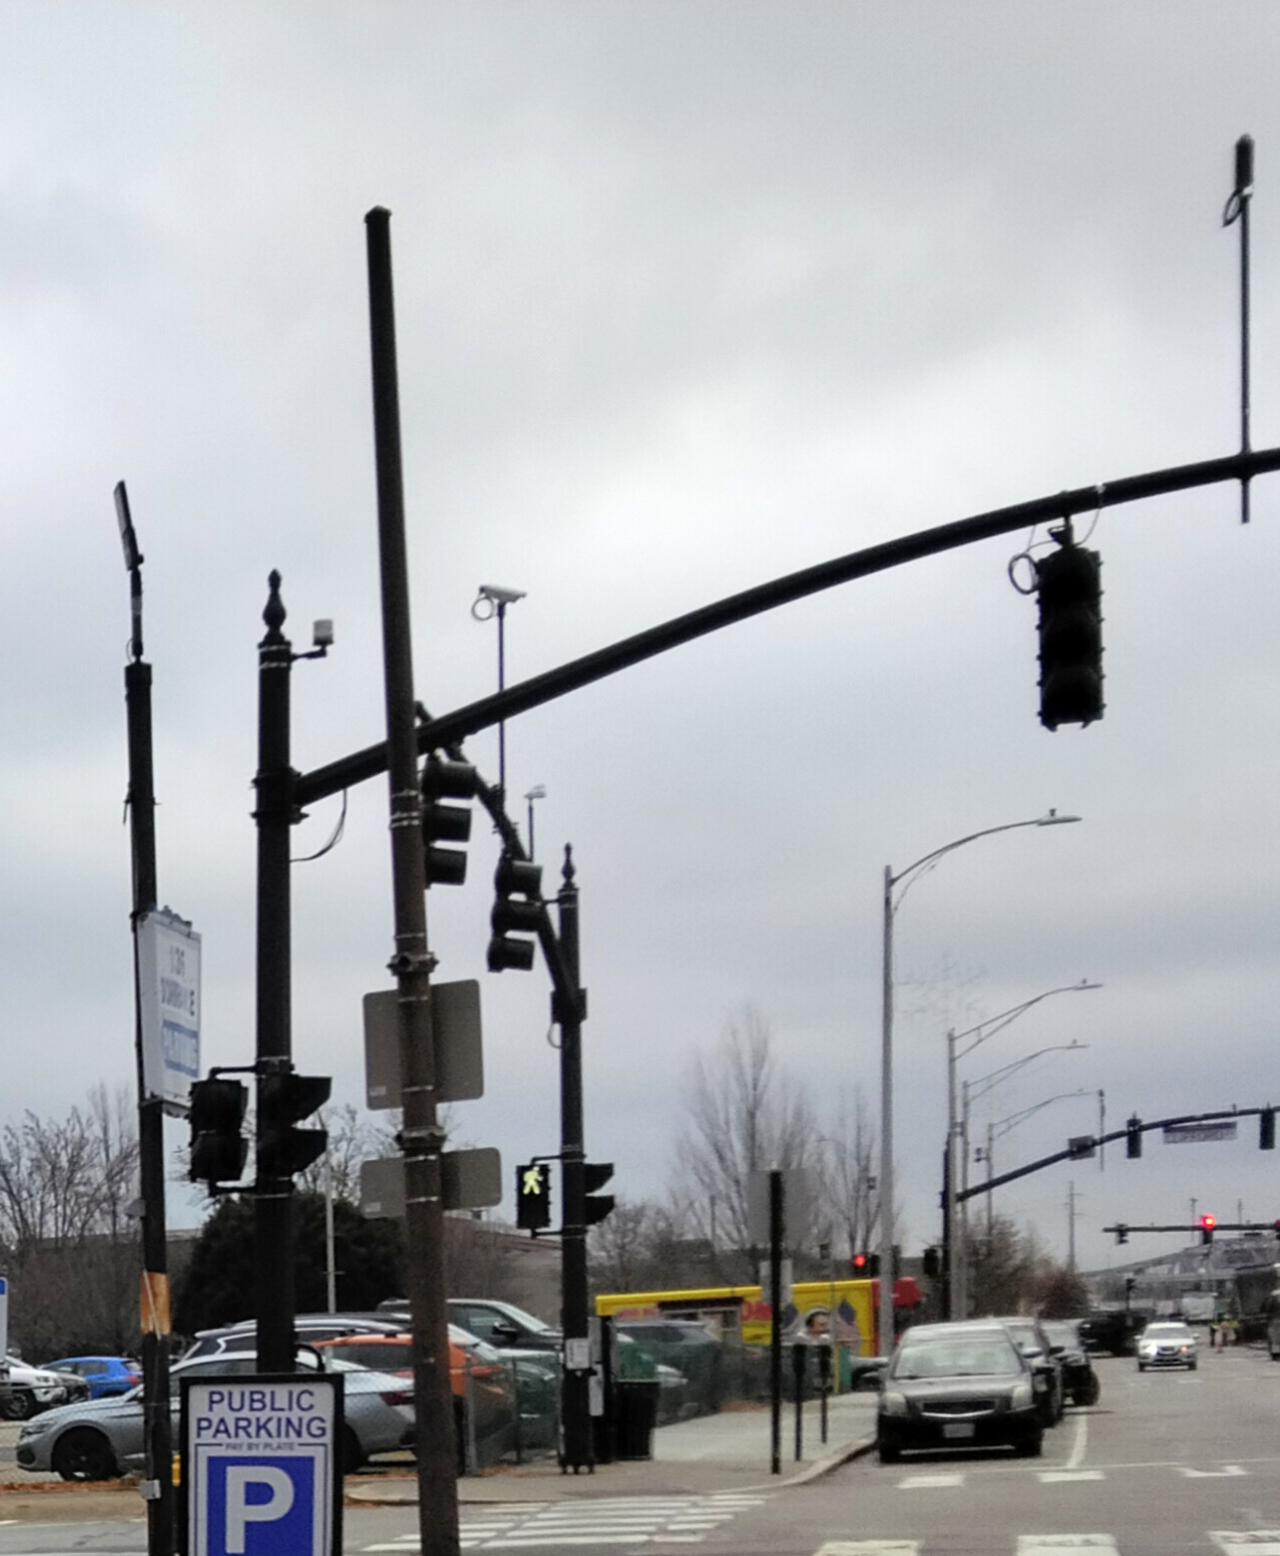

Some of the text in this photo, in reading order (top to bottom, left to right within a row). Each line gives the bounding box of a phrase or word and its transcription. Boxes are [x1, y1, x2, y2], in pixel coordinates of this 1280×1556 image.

[207, 1389, 315, 1413] PUBLIC
[196, 1416, 328, 1440] PARKING
[225, 1441, 295, 1452] PAY BY PLATE
[225, 1465, 295, 1554] P
